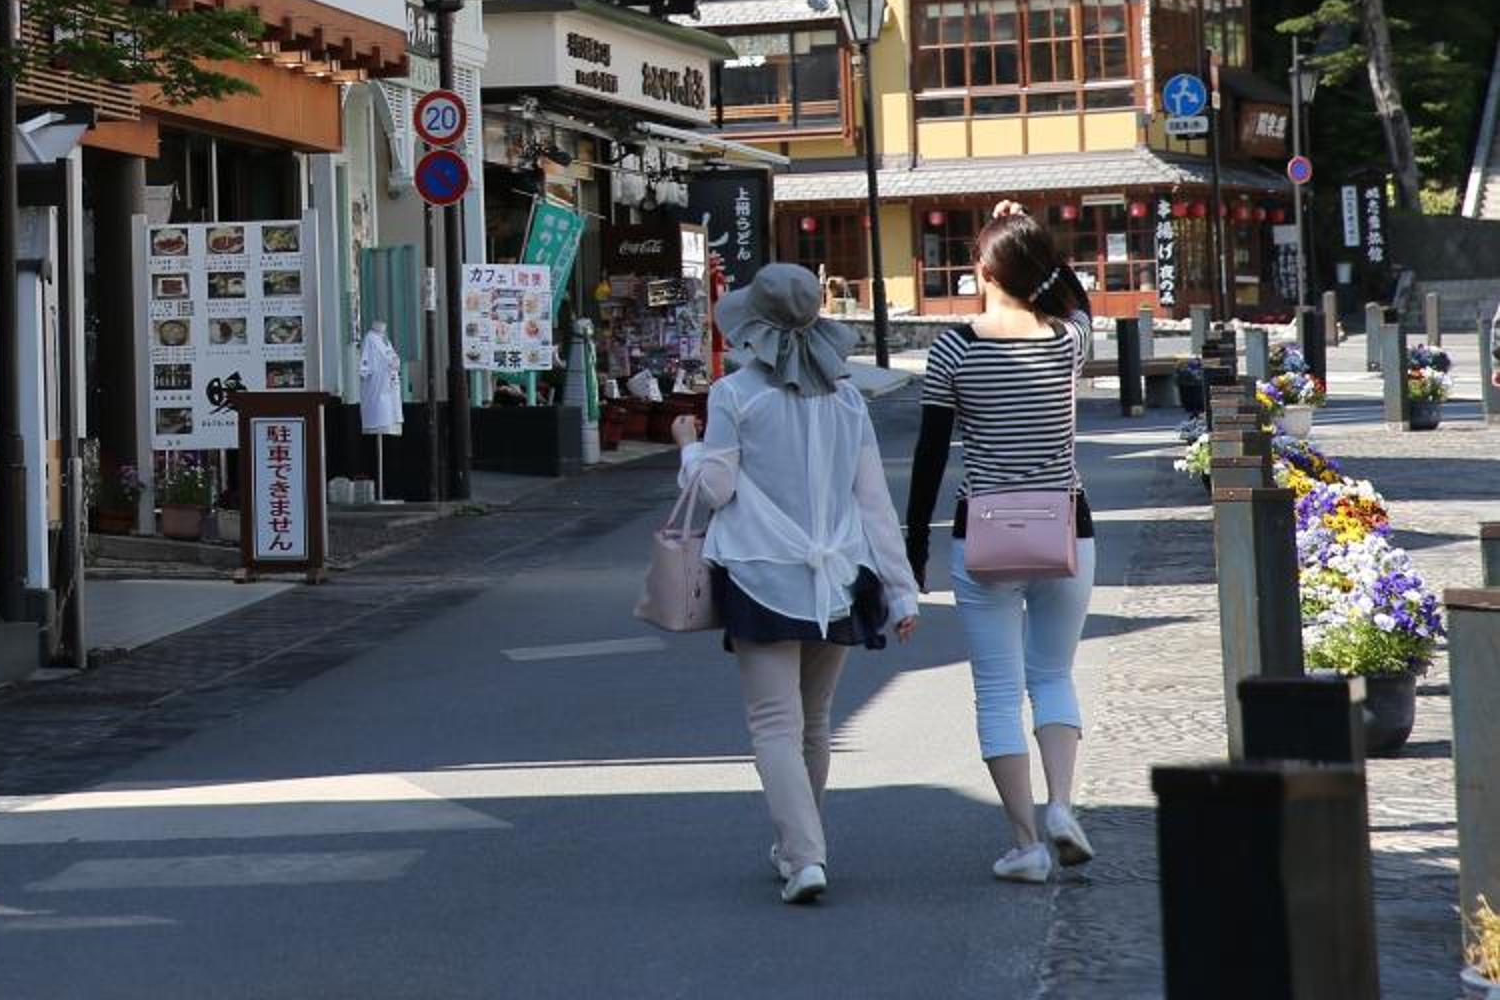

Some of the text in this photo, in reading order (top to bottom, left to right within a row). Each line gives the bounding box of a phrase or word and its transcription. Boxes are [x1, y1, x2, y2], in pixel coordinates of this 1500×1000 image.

[426, 105, 457, 131] 20
[469, 268, 507, 284] カフェ
[266, 425, 292, 550] 駐車できません
